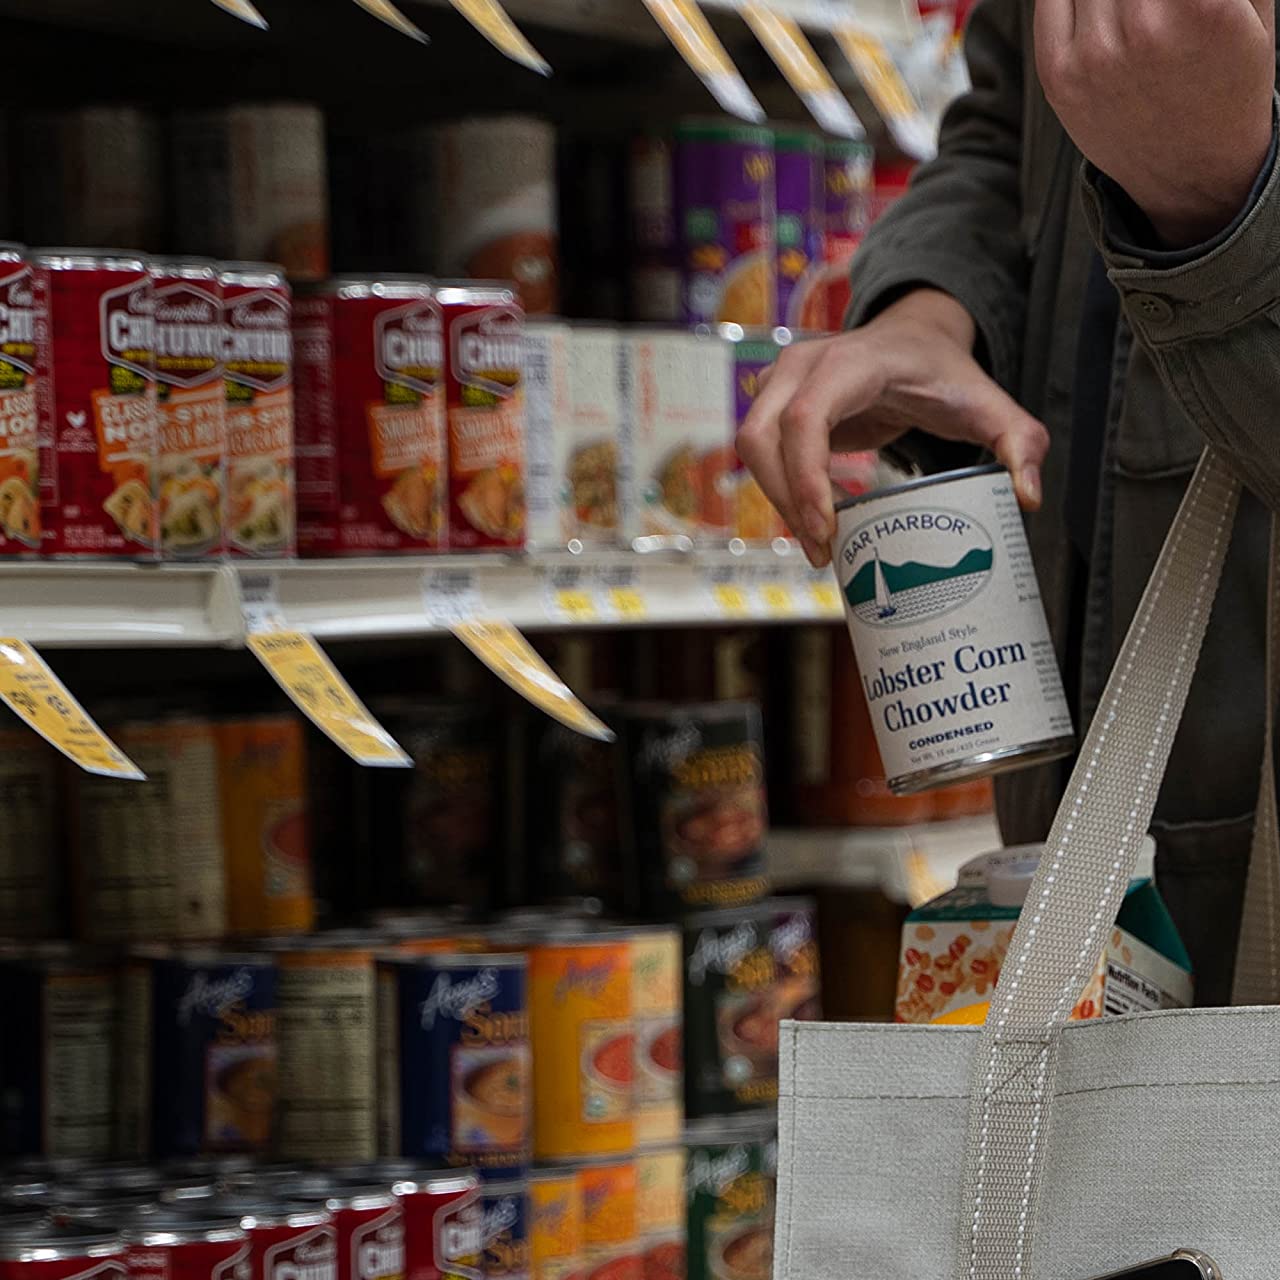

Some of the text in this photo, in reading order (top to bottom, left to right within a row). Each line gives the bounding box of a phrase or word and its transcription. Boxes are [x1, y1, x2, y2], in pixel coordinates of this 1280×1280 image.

[844, 514, 966, 566] BAR HARBOR
[879, 624, 978, 659] New England Style
[863, 642, 1027, 702] Lobster Corn
[884, 681, 1012, 733] Chowder
[908, 721, 994, 751] CONDENSED
